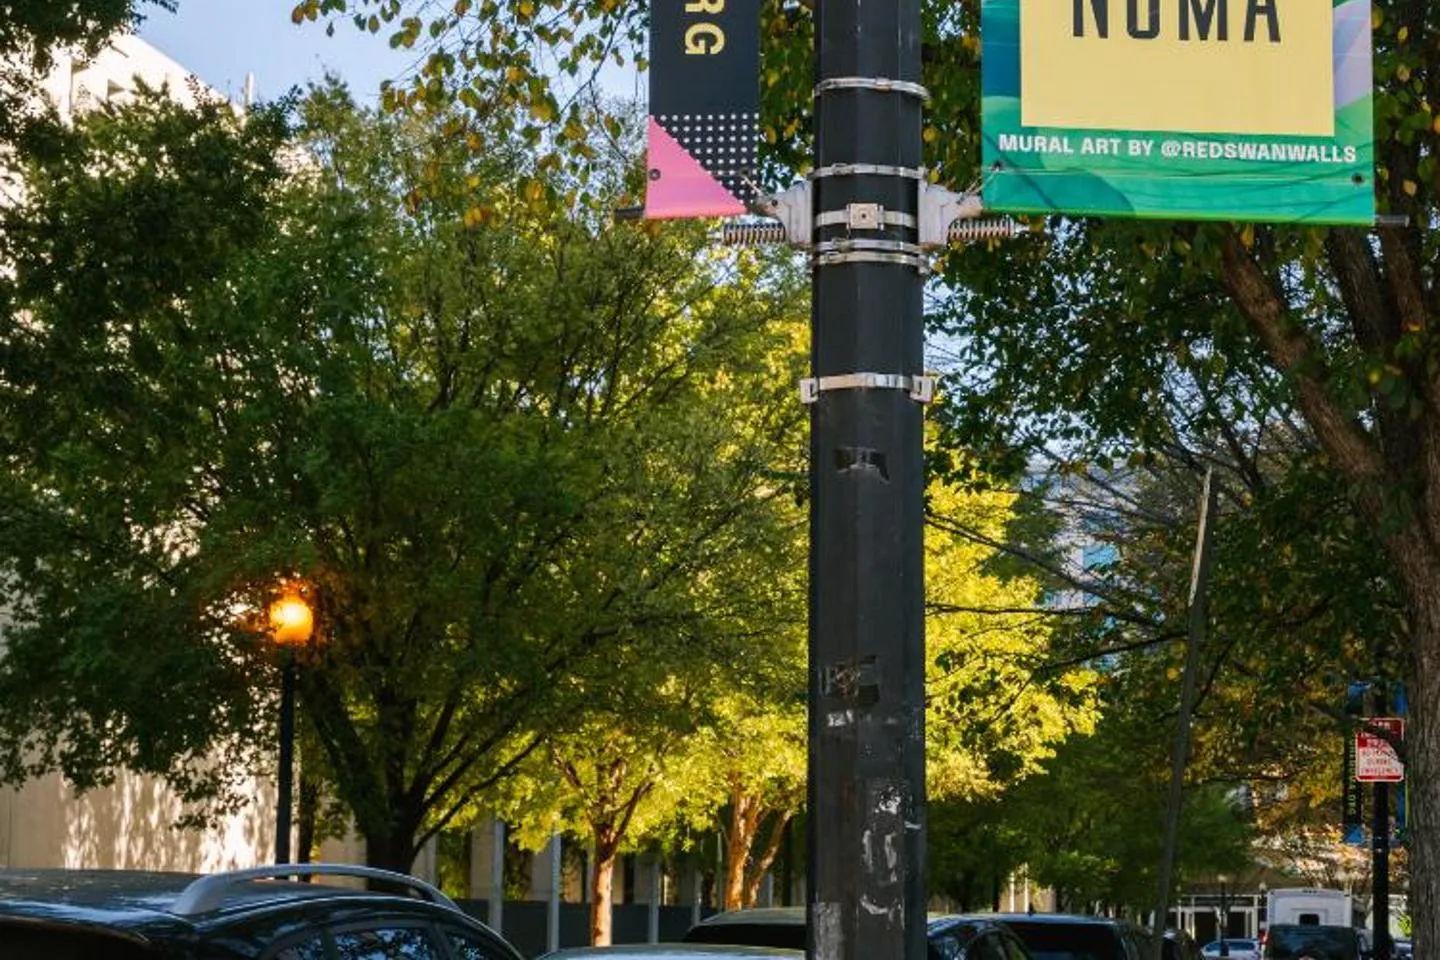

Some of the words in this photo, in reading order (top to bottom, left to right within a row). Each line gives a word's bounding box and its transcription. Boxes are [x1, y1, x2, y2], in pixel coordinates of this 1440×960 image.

[999, 133, 1074, 154] MURAL
[1080, 137, 1121, 156] ART
[1127, 138, 1154, 157] BY
[1160, 139, 1357, 164] @REDSWANWALLS
